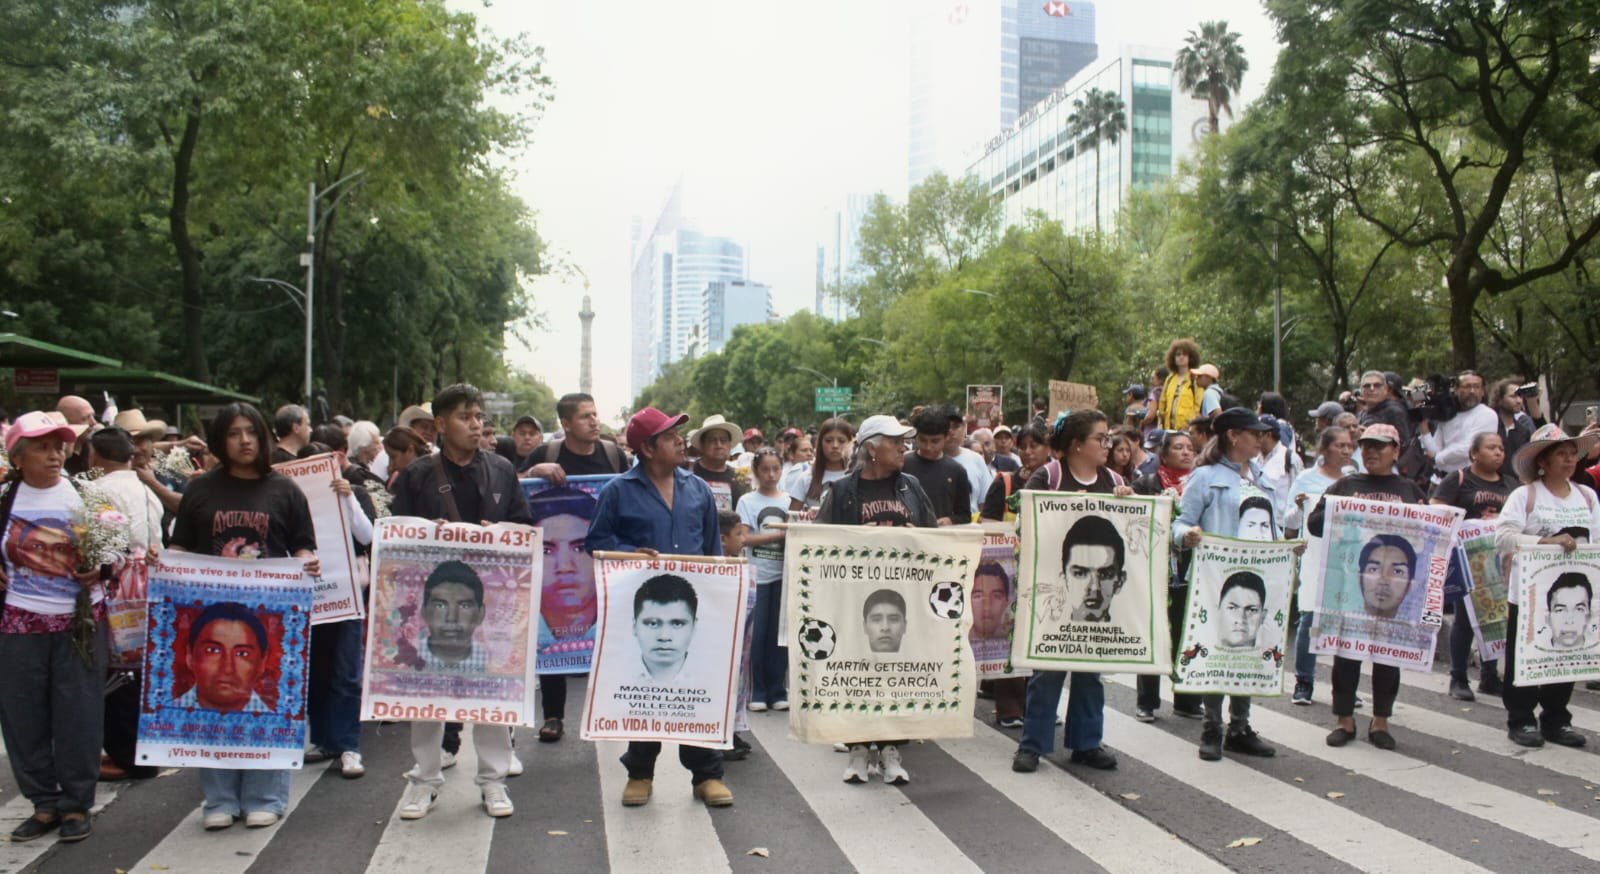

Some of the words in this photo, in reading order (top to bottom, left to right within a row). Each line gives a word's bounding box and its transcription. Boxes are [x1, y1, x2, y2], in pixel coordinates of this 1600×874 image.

[1040, 501, 1068, 513] ¡Vivo
[1071, 502, 1083, 510] se
[1085, 499, 1096, 511] lo
[1099, 501, 1147, 515] llevaron!
[1335, 500, 1366, 513] ¡Vivo
[1370, 504, 1384, 513] se
[1388, 505, 1399, 516] lo
[1403, 507, 1453, 528] llevaron!
[383, 524, 427, 540] ¡Nos
[434, 525, 494, 545] faltan
[499, 530, 531, 547] 43!
[1202, 552, 1226, 563] ¡Vivo
[1240, 556, 1249, 564] lo
[1251, 554, 1290, 565] llevaron!
[1529, 552, 1551, 562] ¡Vivo
[646, 559, 659, 571] se
[664, 560, 676, 571] lo
[681, 563, 738, 576] llevaron!
[820, 565, 846, 579] ¡VIVO
[852, 567, 863, 579] SE
[868, 567, 880, 580] LO
[884, 568, 934, 582] LLEVARON!
[200, 568, 223, 577] vivo
[241, 569, 252, 578] lo
[255, 569, 303, 581] llevaron!
[1059, 623, 1089, 634] CÉSAR
[1089, 626, 1125, 635] MANUEL
[1042, 631, 1087, 642] GONZÁLEZ
[1089, 634, 1141, 644] HERNÁNDEZ
[1035, 643, 1057, 654] ¡Con
[1059, 644, 1082, 655] VIDA
[1084, 645, 1093, 655] lo
[1095, 646, 1147, 657] queremos!
[1322, 637, 1351, 649] ¡Vivo
[1355, 639, 1365, 651] lo
[1367, 643, 1424, 661] queremos!
[826, 659, 870, 671] MARTÍN
[874, 662, 943, 672] GETSEMANY
[1187, 670, 1205, 678] ¡Con
[1226, 670, 1234, 678] lo
[1544, 668, 1562, 677] VIDA
[821, 672, 882, 687] SÁNCHEZ
[887, 673, 938, 688] GARCÍA
[619, 685, 707, 695] MAGDALENO
[814, 687, 839, 697] ¡Con
[845, 689, 871, 697] VIDA
[876, 689, 885, 697] lo
[890, 690, 944, 699] queremos!
[613, 693, 662, 701] RUBÉN
[665, 695, 711, 703] LAURO
[373, 701, 447, 720] Dónde
[454, 706, 518, 723] están
[629, 702, 695, 711] VILLEGAS
[675, 710, 696, 718] AÑOS
[594, 717, 618, 732] ¡Con
[622, 719, 648, 731] VIDA
[652, 719, 661, 732] lo
[664, 721, 720, 735] queremos!
[168, 747, 197, 758] ¡Vivo
[200, 749, 211, 758] lo
[214, 751, 271, 760] queremos!
